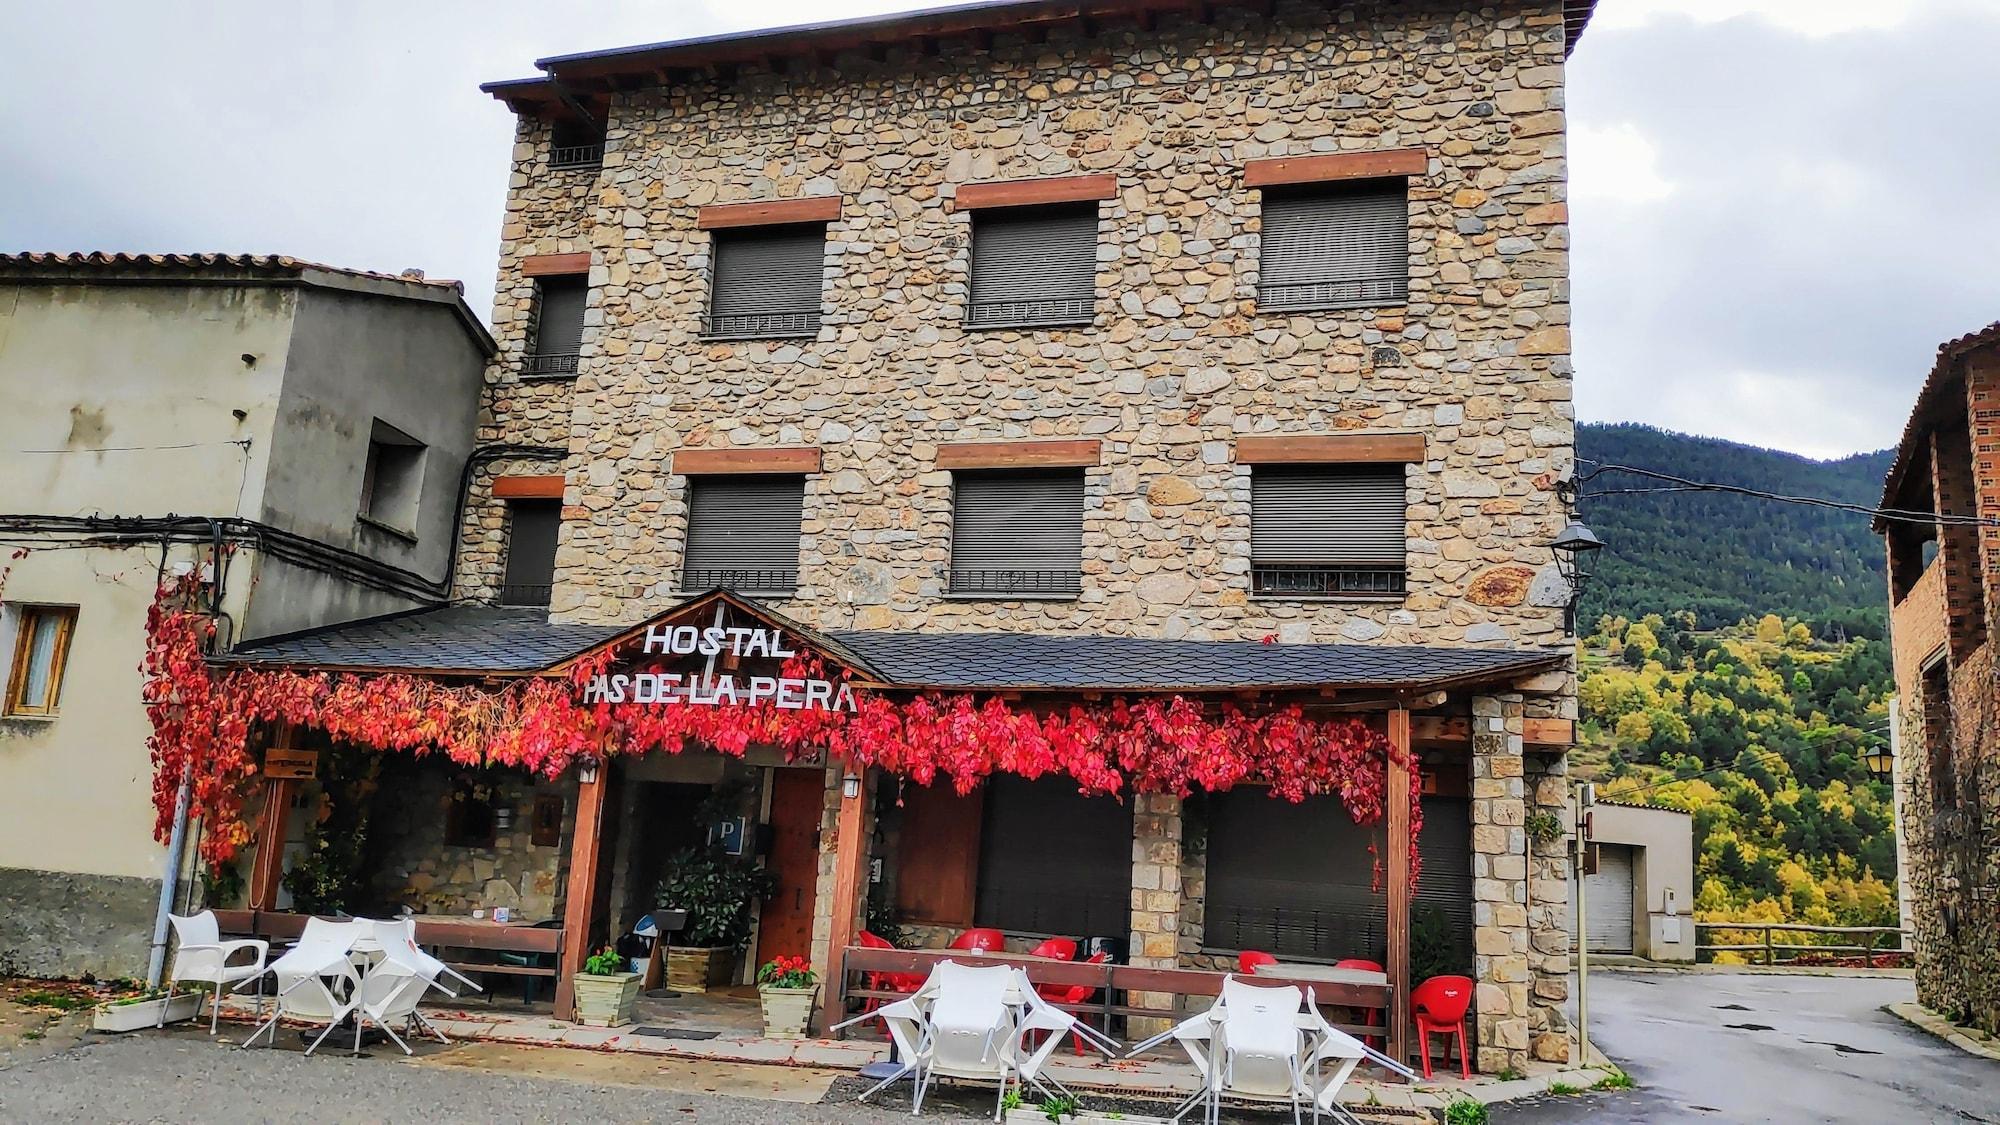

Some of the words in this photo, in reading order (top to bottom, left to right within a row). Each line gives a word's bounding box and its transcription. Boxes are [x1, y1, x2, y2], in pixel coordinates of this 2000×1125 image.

[643, 625, 795, 658] HOSTAL
[583, 674, 629, 704] PAS
[633, 674, 682, 704] DE
[689, 675, 737, 705] LA
[748, 676, 858, 712] PERA
[720, 821, 735, 839] P
